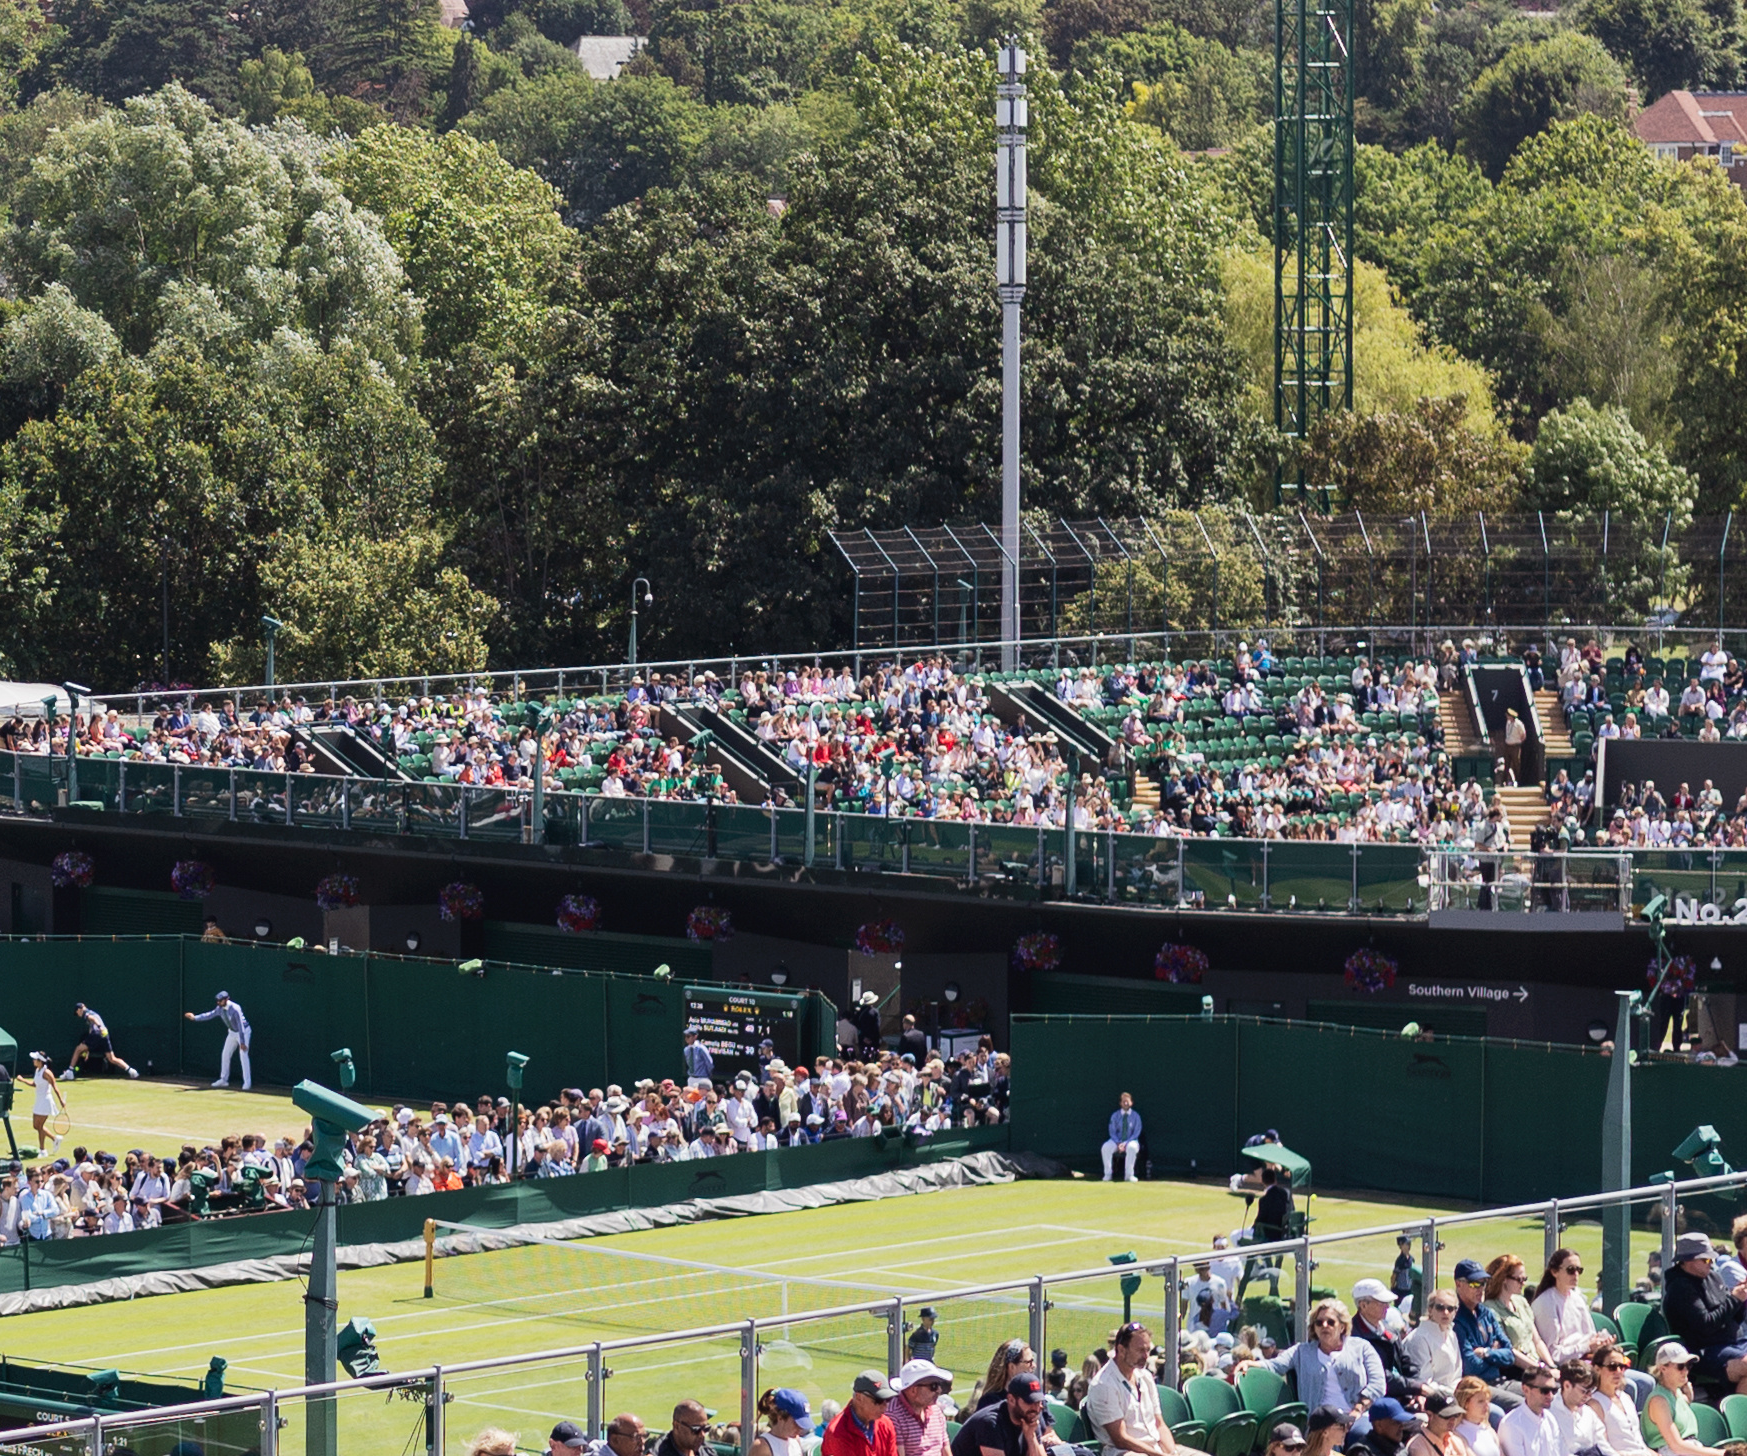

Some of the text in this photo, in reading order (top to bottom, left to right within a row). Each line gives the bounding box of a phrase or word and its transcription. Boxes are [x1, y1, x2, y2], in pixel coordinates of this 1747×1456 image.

[1491, 690, 1499, 702] 7
[1409, 984, 1509, 1001] Southern Village
[729, 996, 749, 1004] COURT
[36, 1411, 65, 1422] COURT
